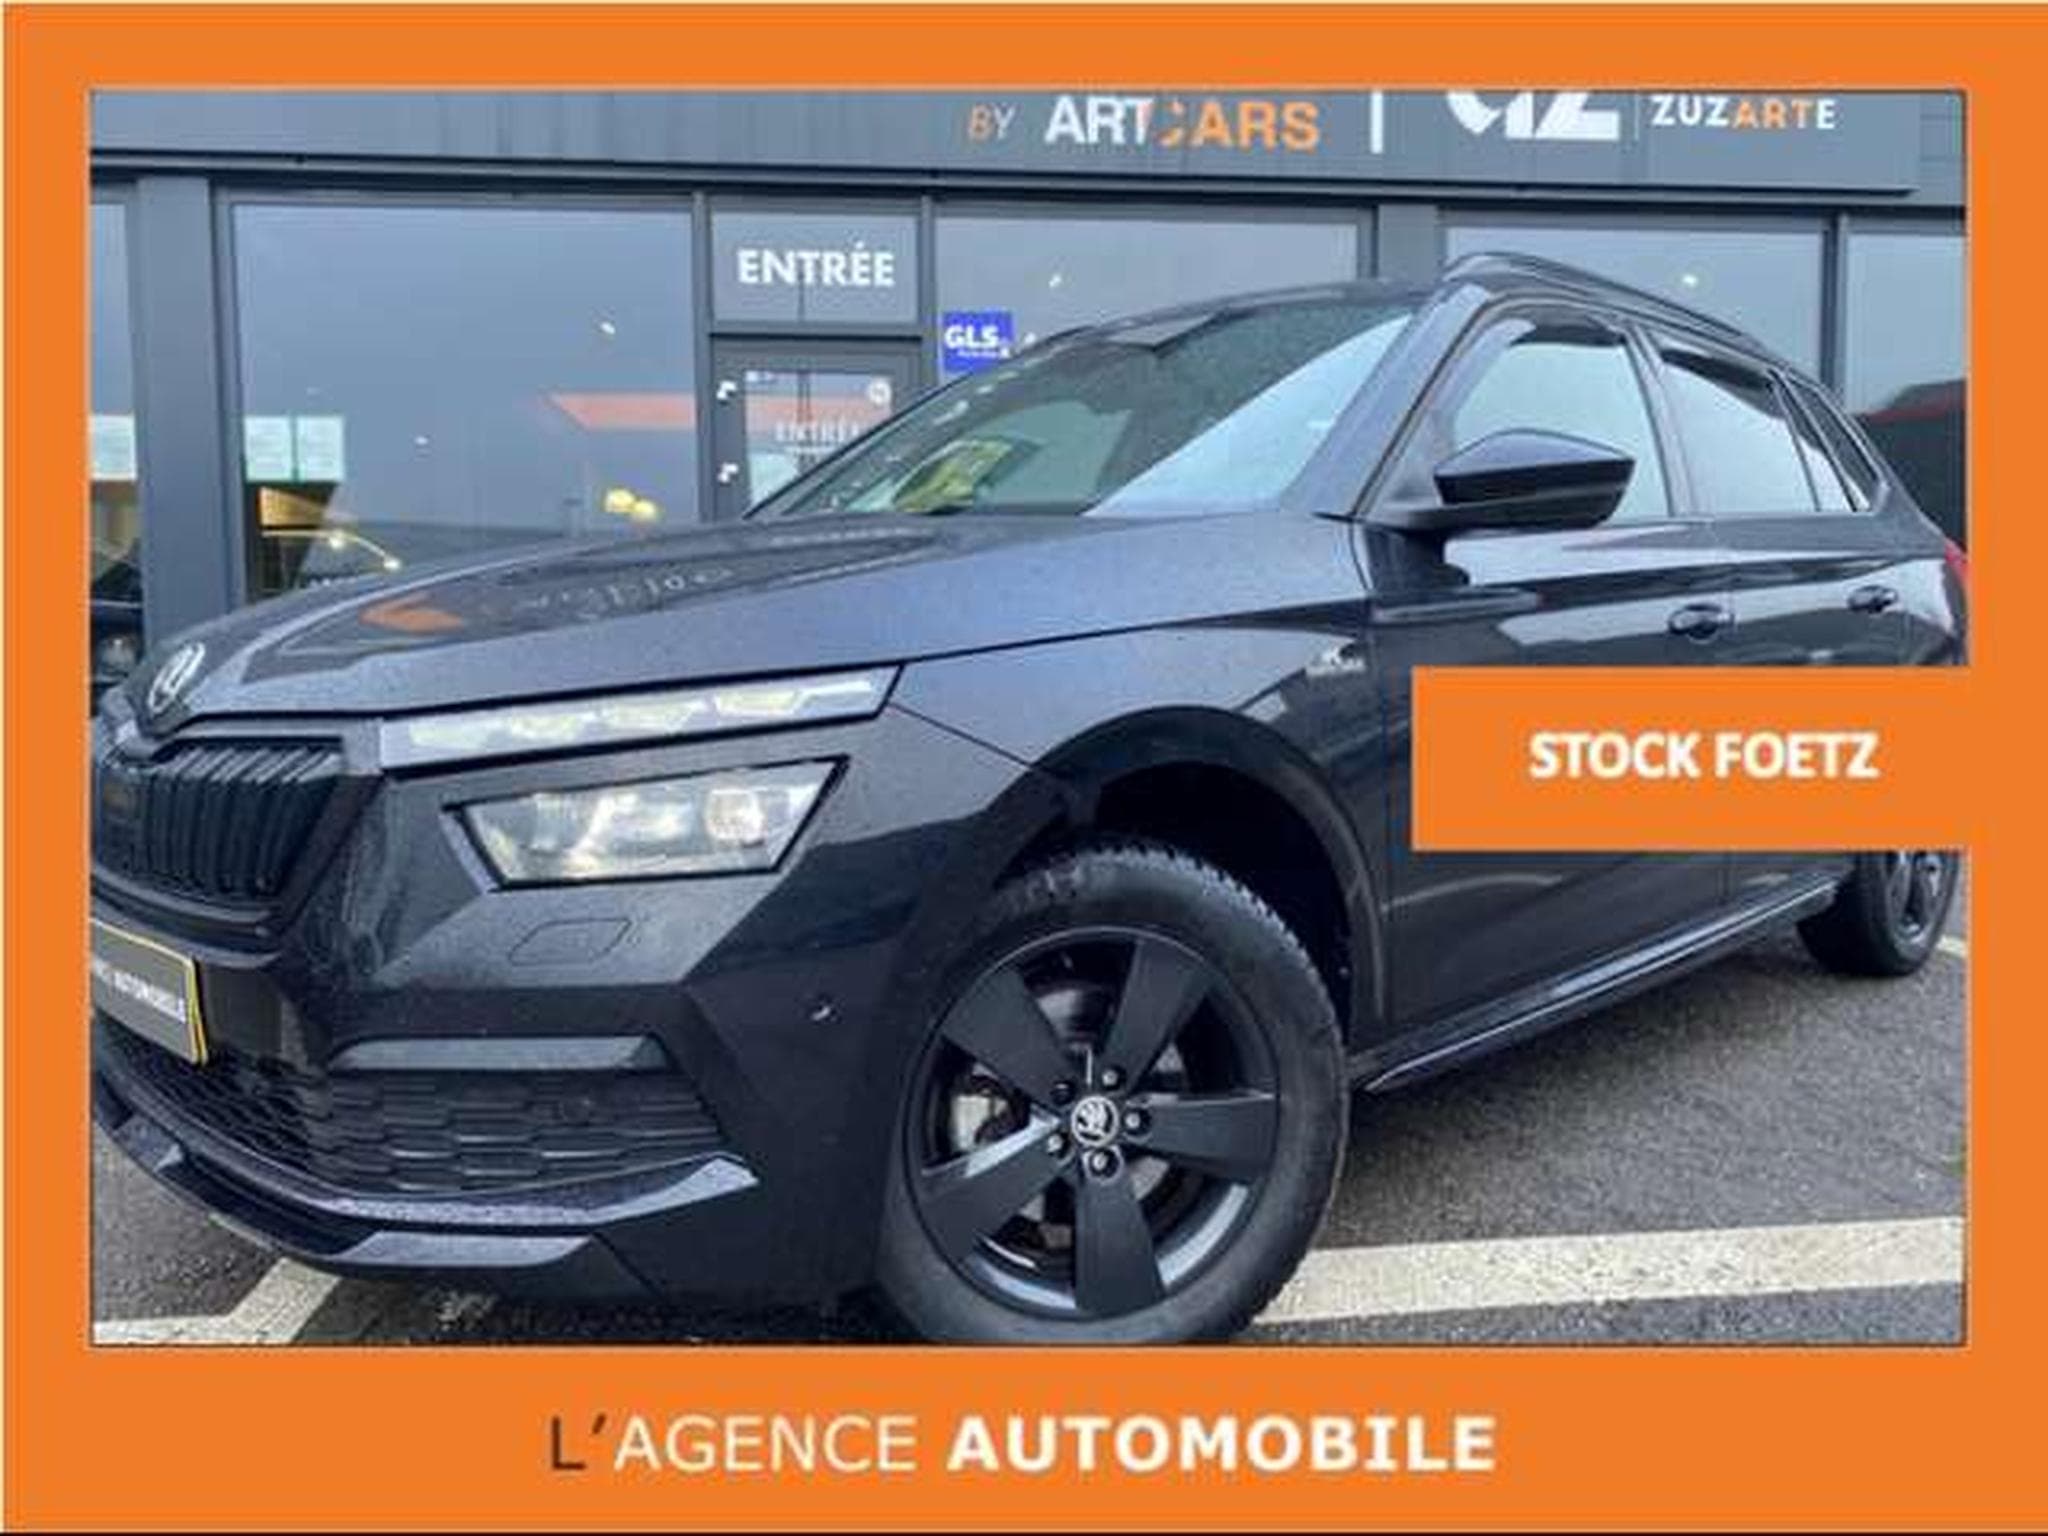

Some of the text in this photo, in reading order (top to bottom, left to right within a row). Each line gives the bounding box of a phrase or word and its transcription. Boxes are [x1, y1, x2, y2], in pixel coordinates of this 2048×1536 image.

[968, 104, 1016, 141] BY
[1650, 93, 1836, 130] ZUZARTE
[737, 240, 895, 287] ENTRÉE
[943, 325, 1000, 349] GLS
